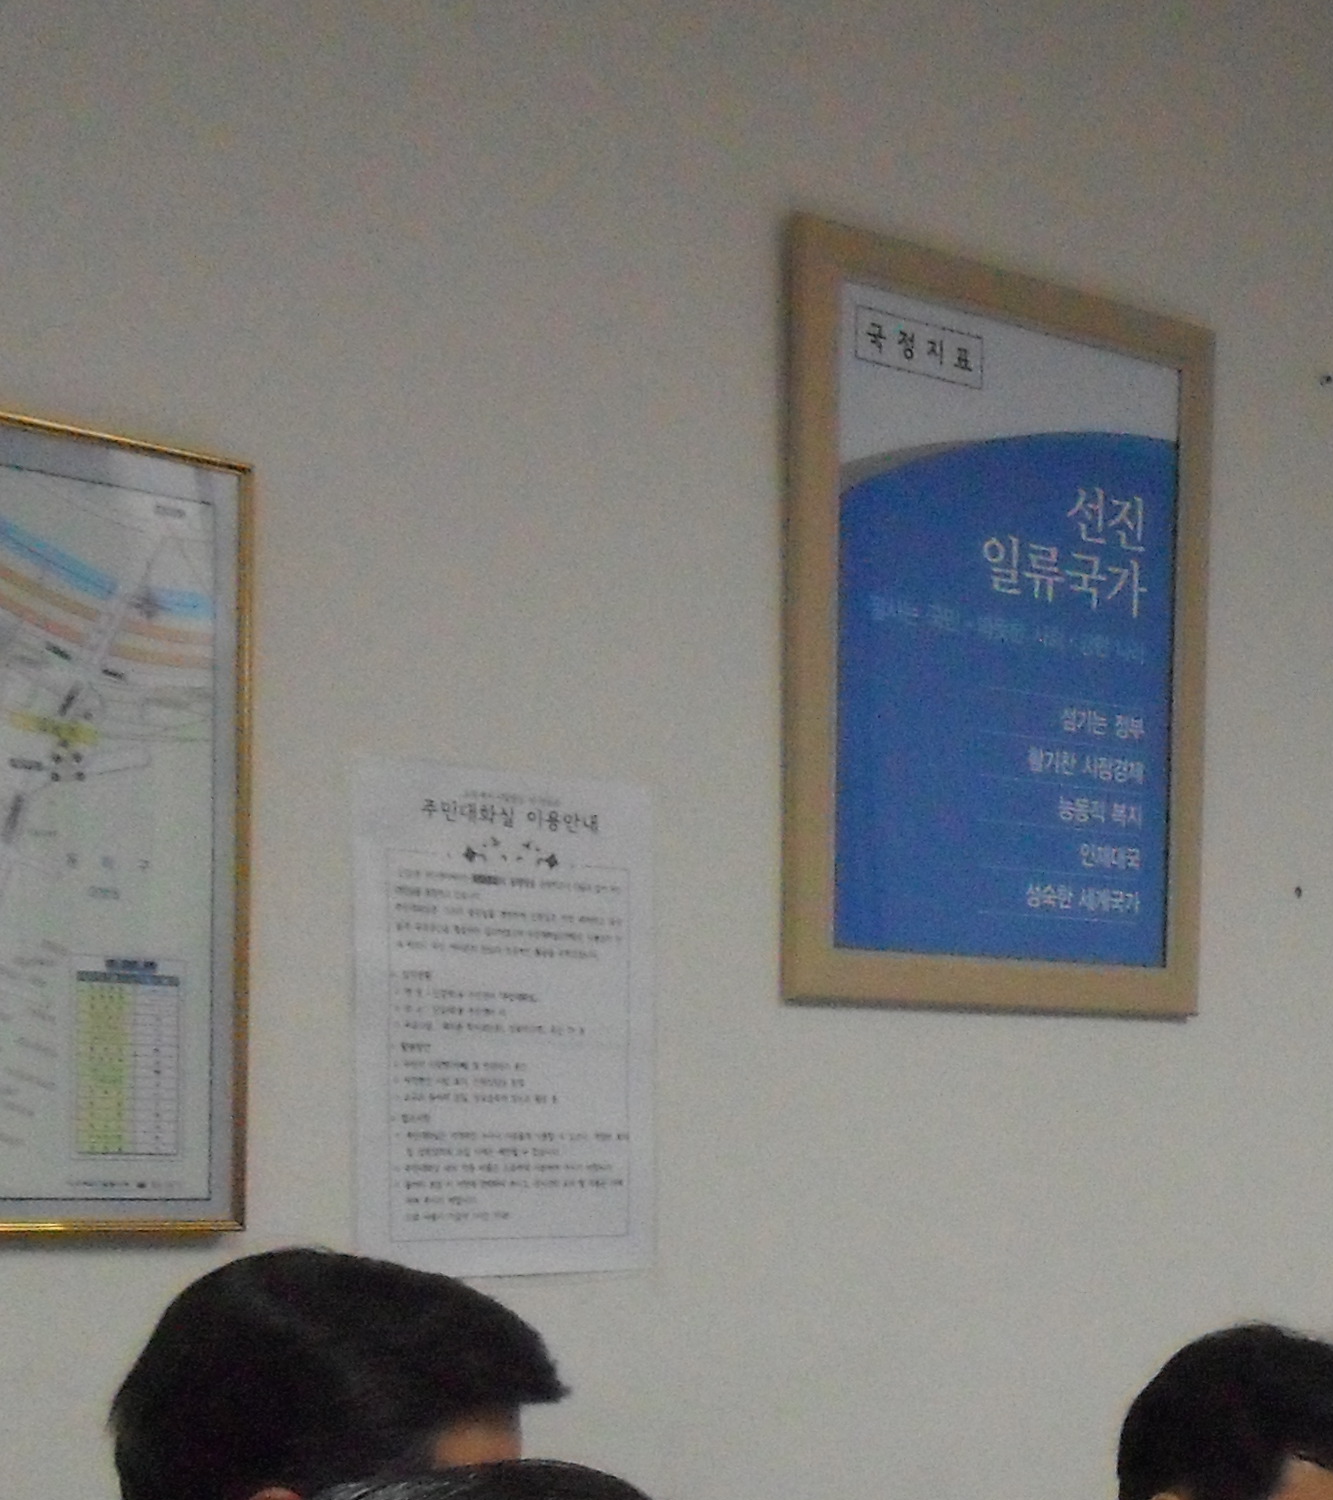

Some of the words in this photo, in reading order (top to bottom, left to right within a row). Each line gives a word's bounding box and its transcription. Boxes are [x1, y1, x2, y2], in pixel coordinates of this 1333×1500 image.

[866, 322, 973, 372] 국정지표
[1066, 487, 1146, 552] 선진
[982, 533, 1148, 618] 일류국가
[1115, 714, 1145, 739] 정부
[527, 808, 598, 834] 이용안내
